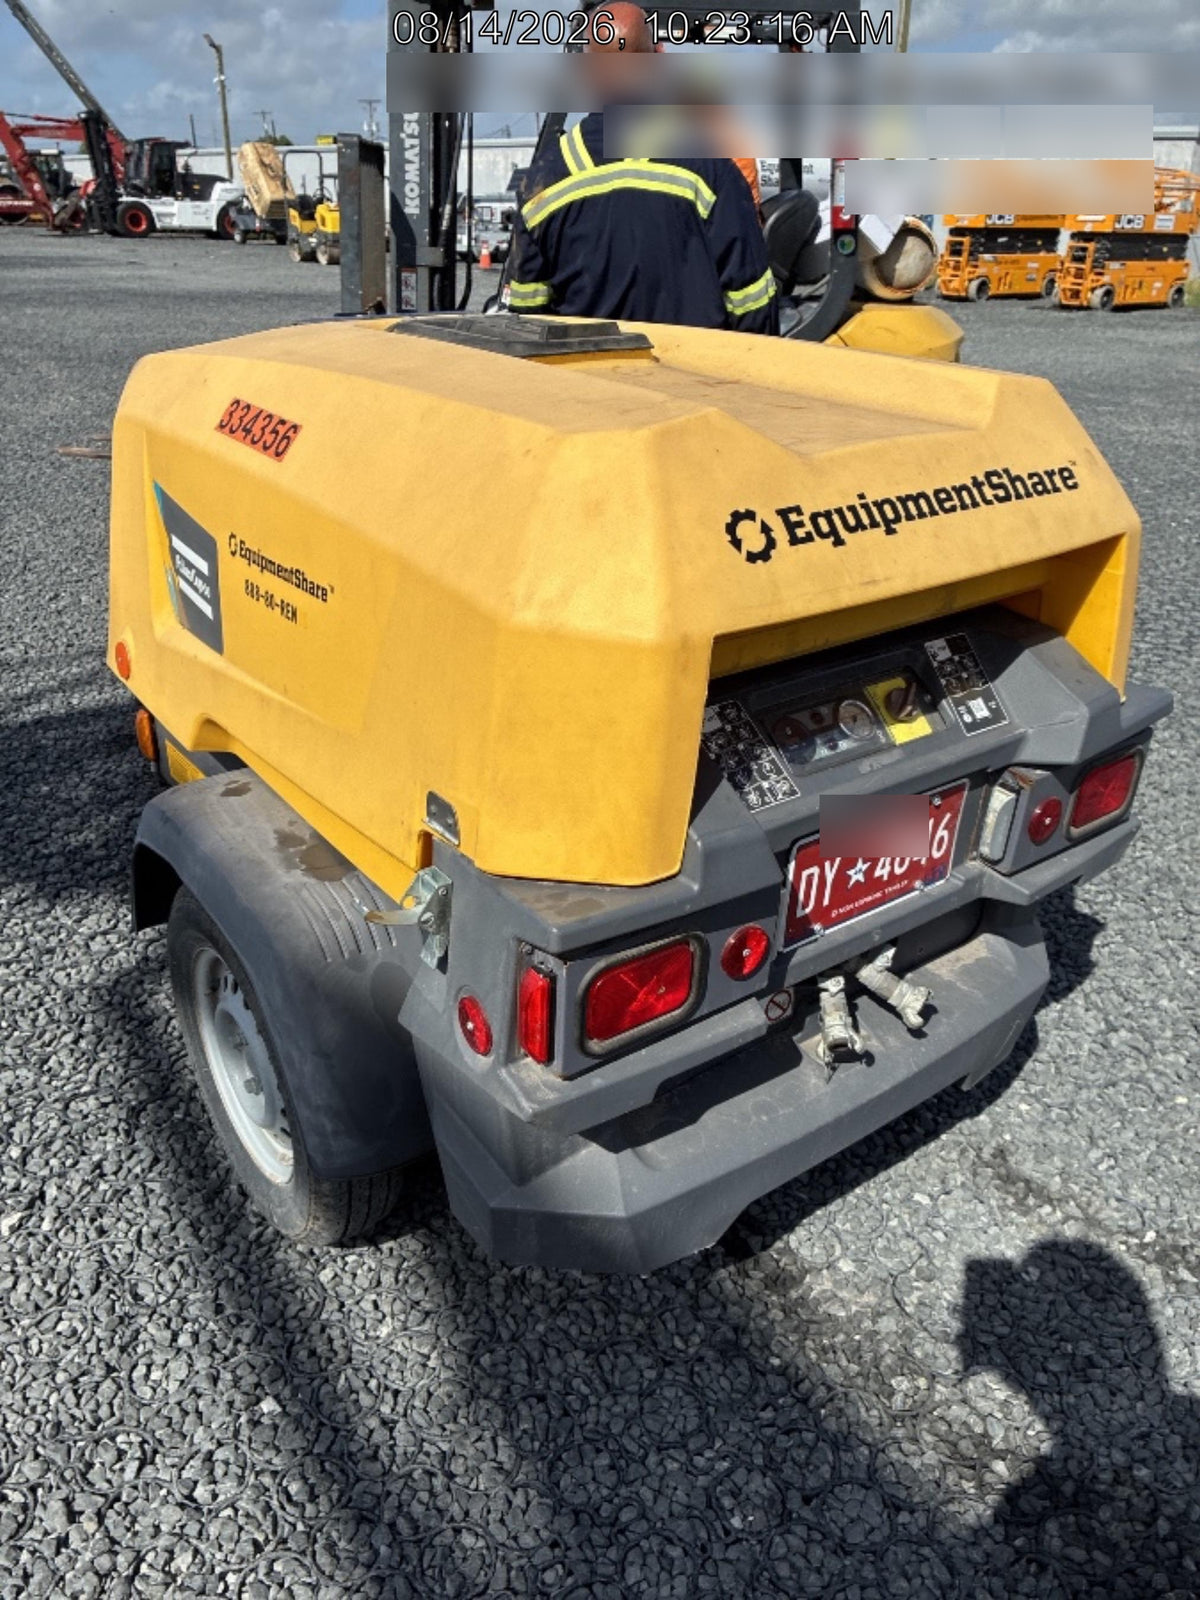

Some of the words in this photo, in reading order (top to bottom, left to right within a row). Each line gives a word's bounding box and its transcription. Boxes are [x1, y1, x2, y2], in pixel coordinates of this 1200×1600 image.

[985, 213, 1015, 225] JCB
[1114, 214, 1145, 229] JCB
[219, 399, 298, 458] 334356
[775, 465, 1079, 548] EquipmentShare
[239, 538, 328, 603] EquipmentShare
